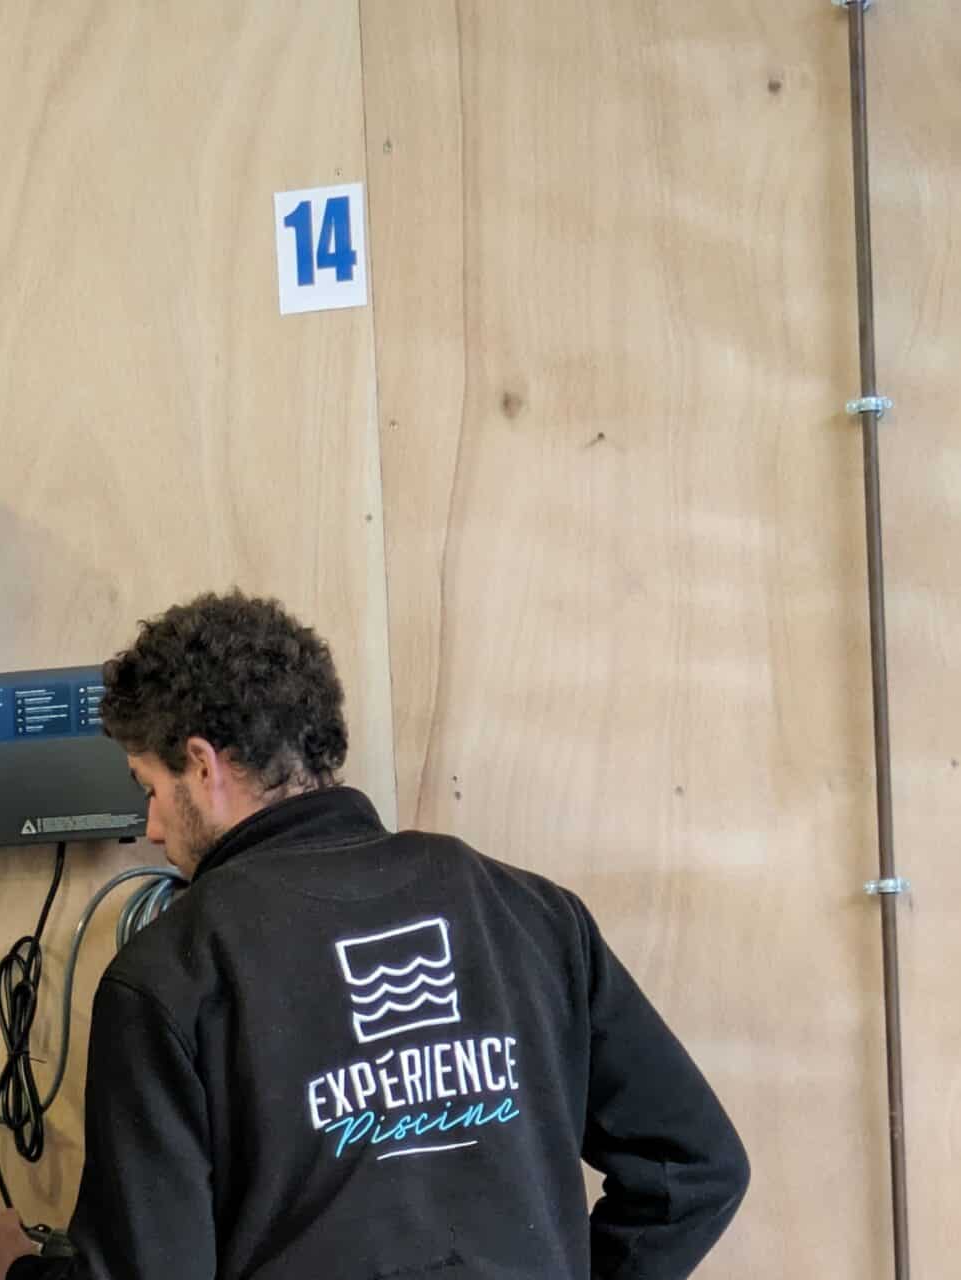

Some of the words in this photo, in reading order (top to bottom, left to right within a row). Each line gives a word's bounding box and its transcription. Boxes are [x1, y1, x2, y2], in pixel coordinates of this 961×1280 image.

[284, 195, 357, 287] 14
[307, 1036, 520, 1131] EXPÉRIENCE
[325, 1096, 520, 1159] Piscine
